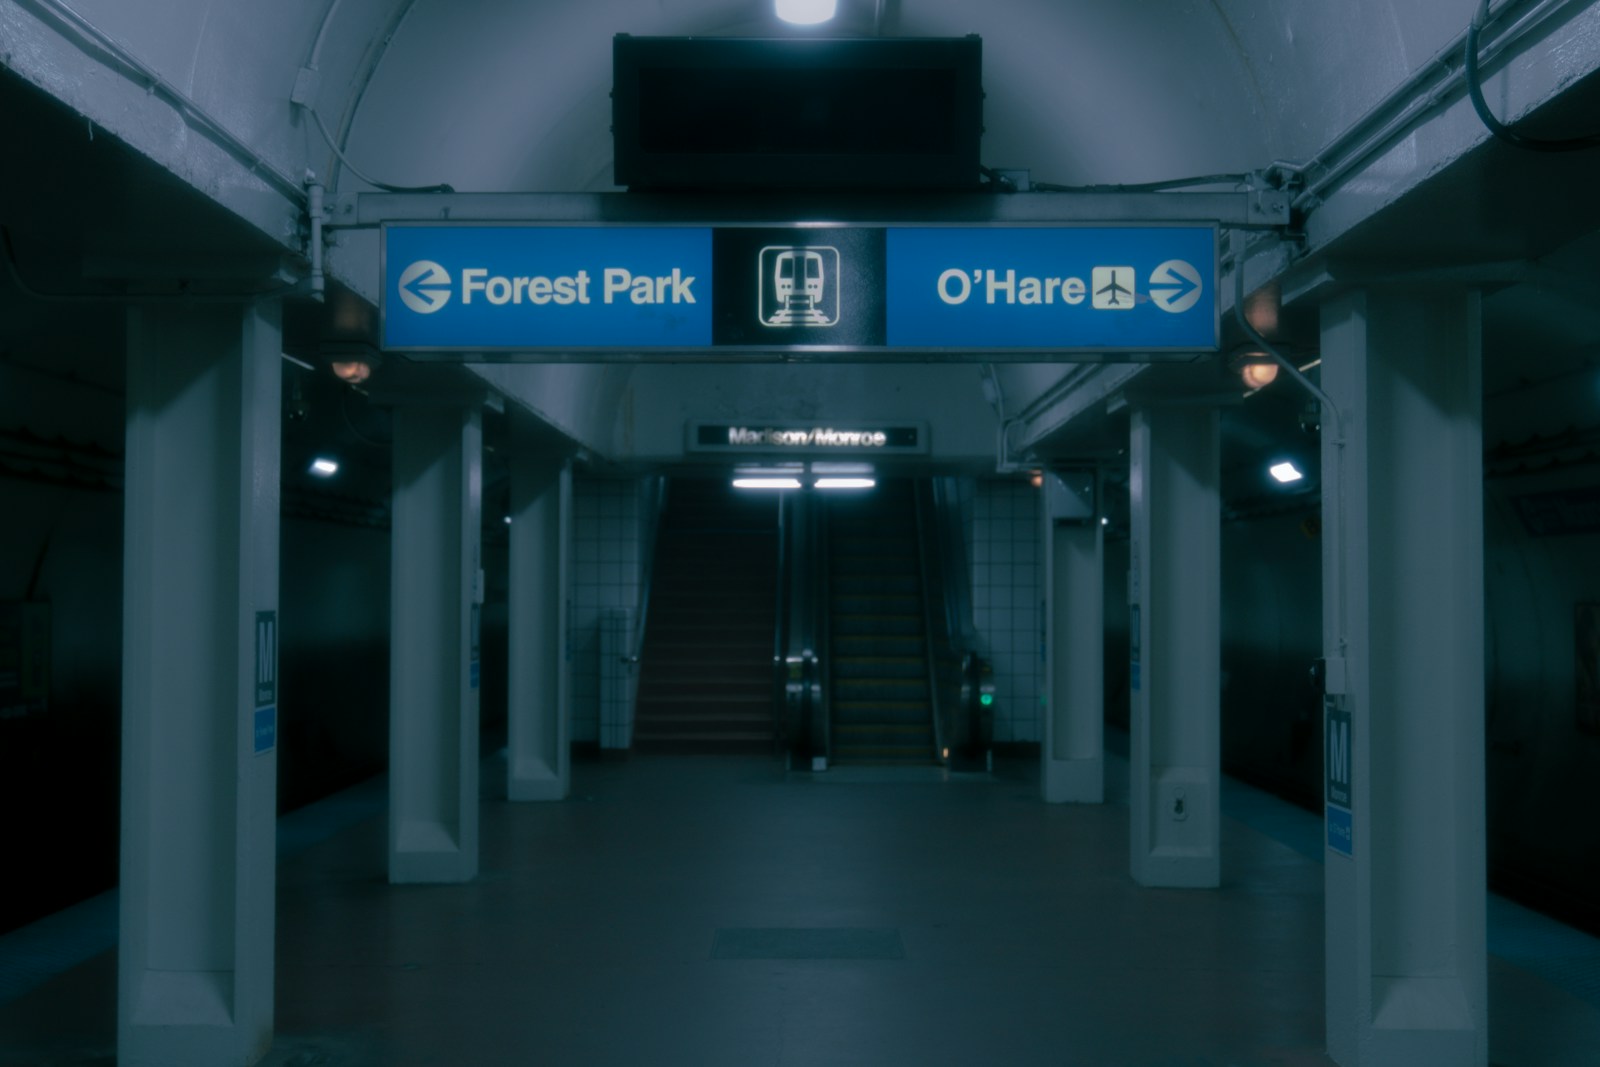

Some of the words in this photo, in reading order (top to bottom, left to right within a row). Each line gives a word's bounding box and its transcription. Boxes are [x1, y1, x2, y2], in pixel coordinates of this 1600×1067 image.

[461, 268, 591, 305] Forest
[603, 267, 697, 304] Park
[936, 267, 1086, 305] O'Hare
[728, 425, 888, 447] Madison/Monroe
[258, 621, 273, 683] M
[1330, 719, 1347, 785] M
